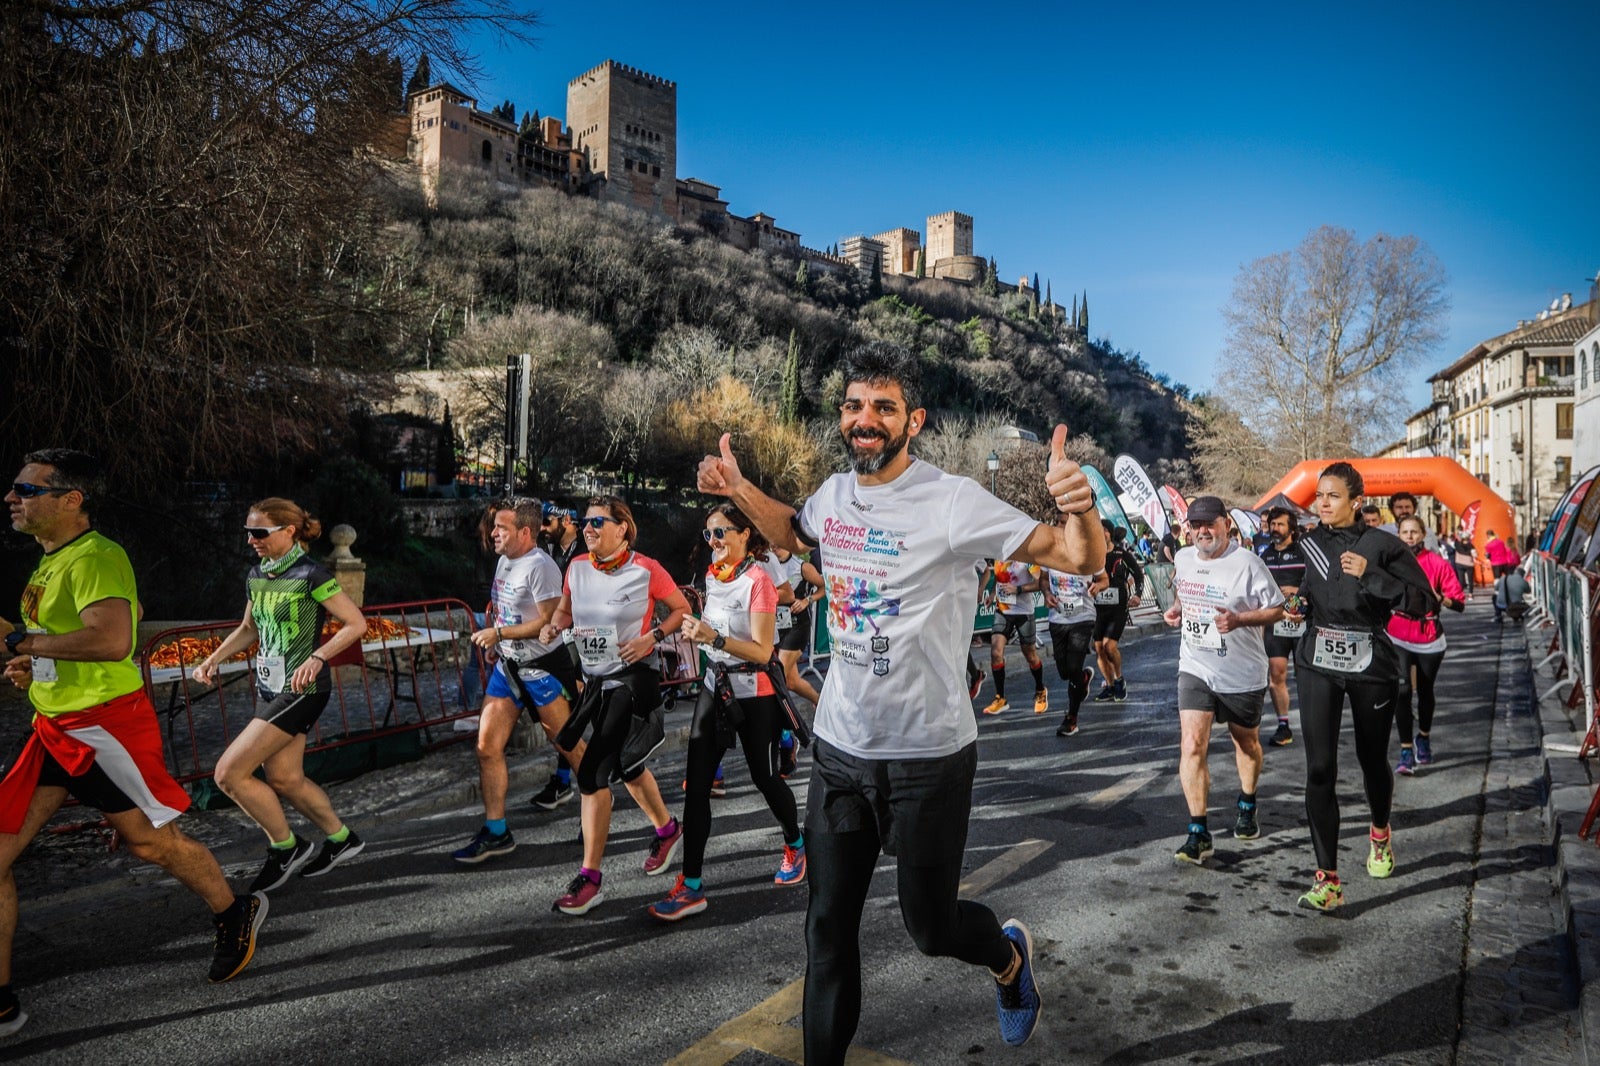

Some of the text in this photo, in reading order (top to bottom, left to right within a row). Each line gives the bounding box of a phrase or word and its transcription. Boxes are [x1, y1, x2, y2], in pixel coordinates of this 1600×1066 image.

[868, 527, 884, 537] Ave
[867, 536, 890, 547] María
[863, 544, 900, 557] Granada
[1100, 591, 1114, 600] 144
[1186, 619, 1210, 635] 387
[581, 636, 608, 650] 142
[841, 640, 867, 653] PUERTA
[1325, 639, 1357, 656] 551
